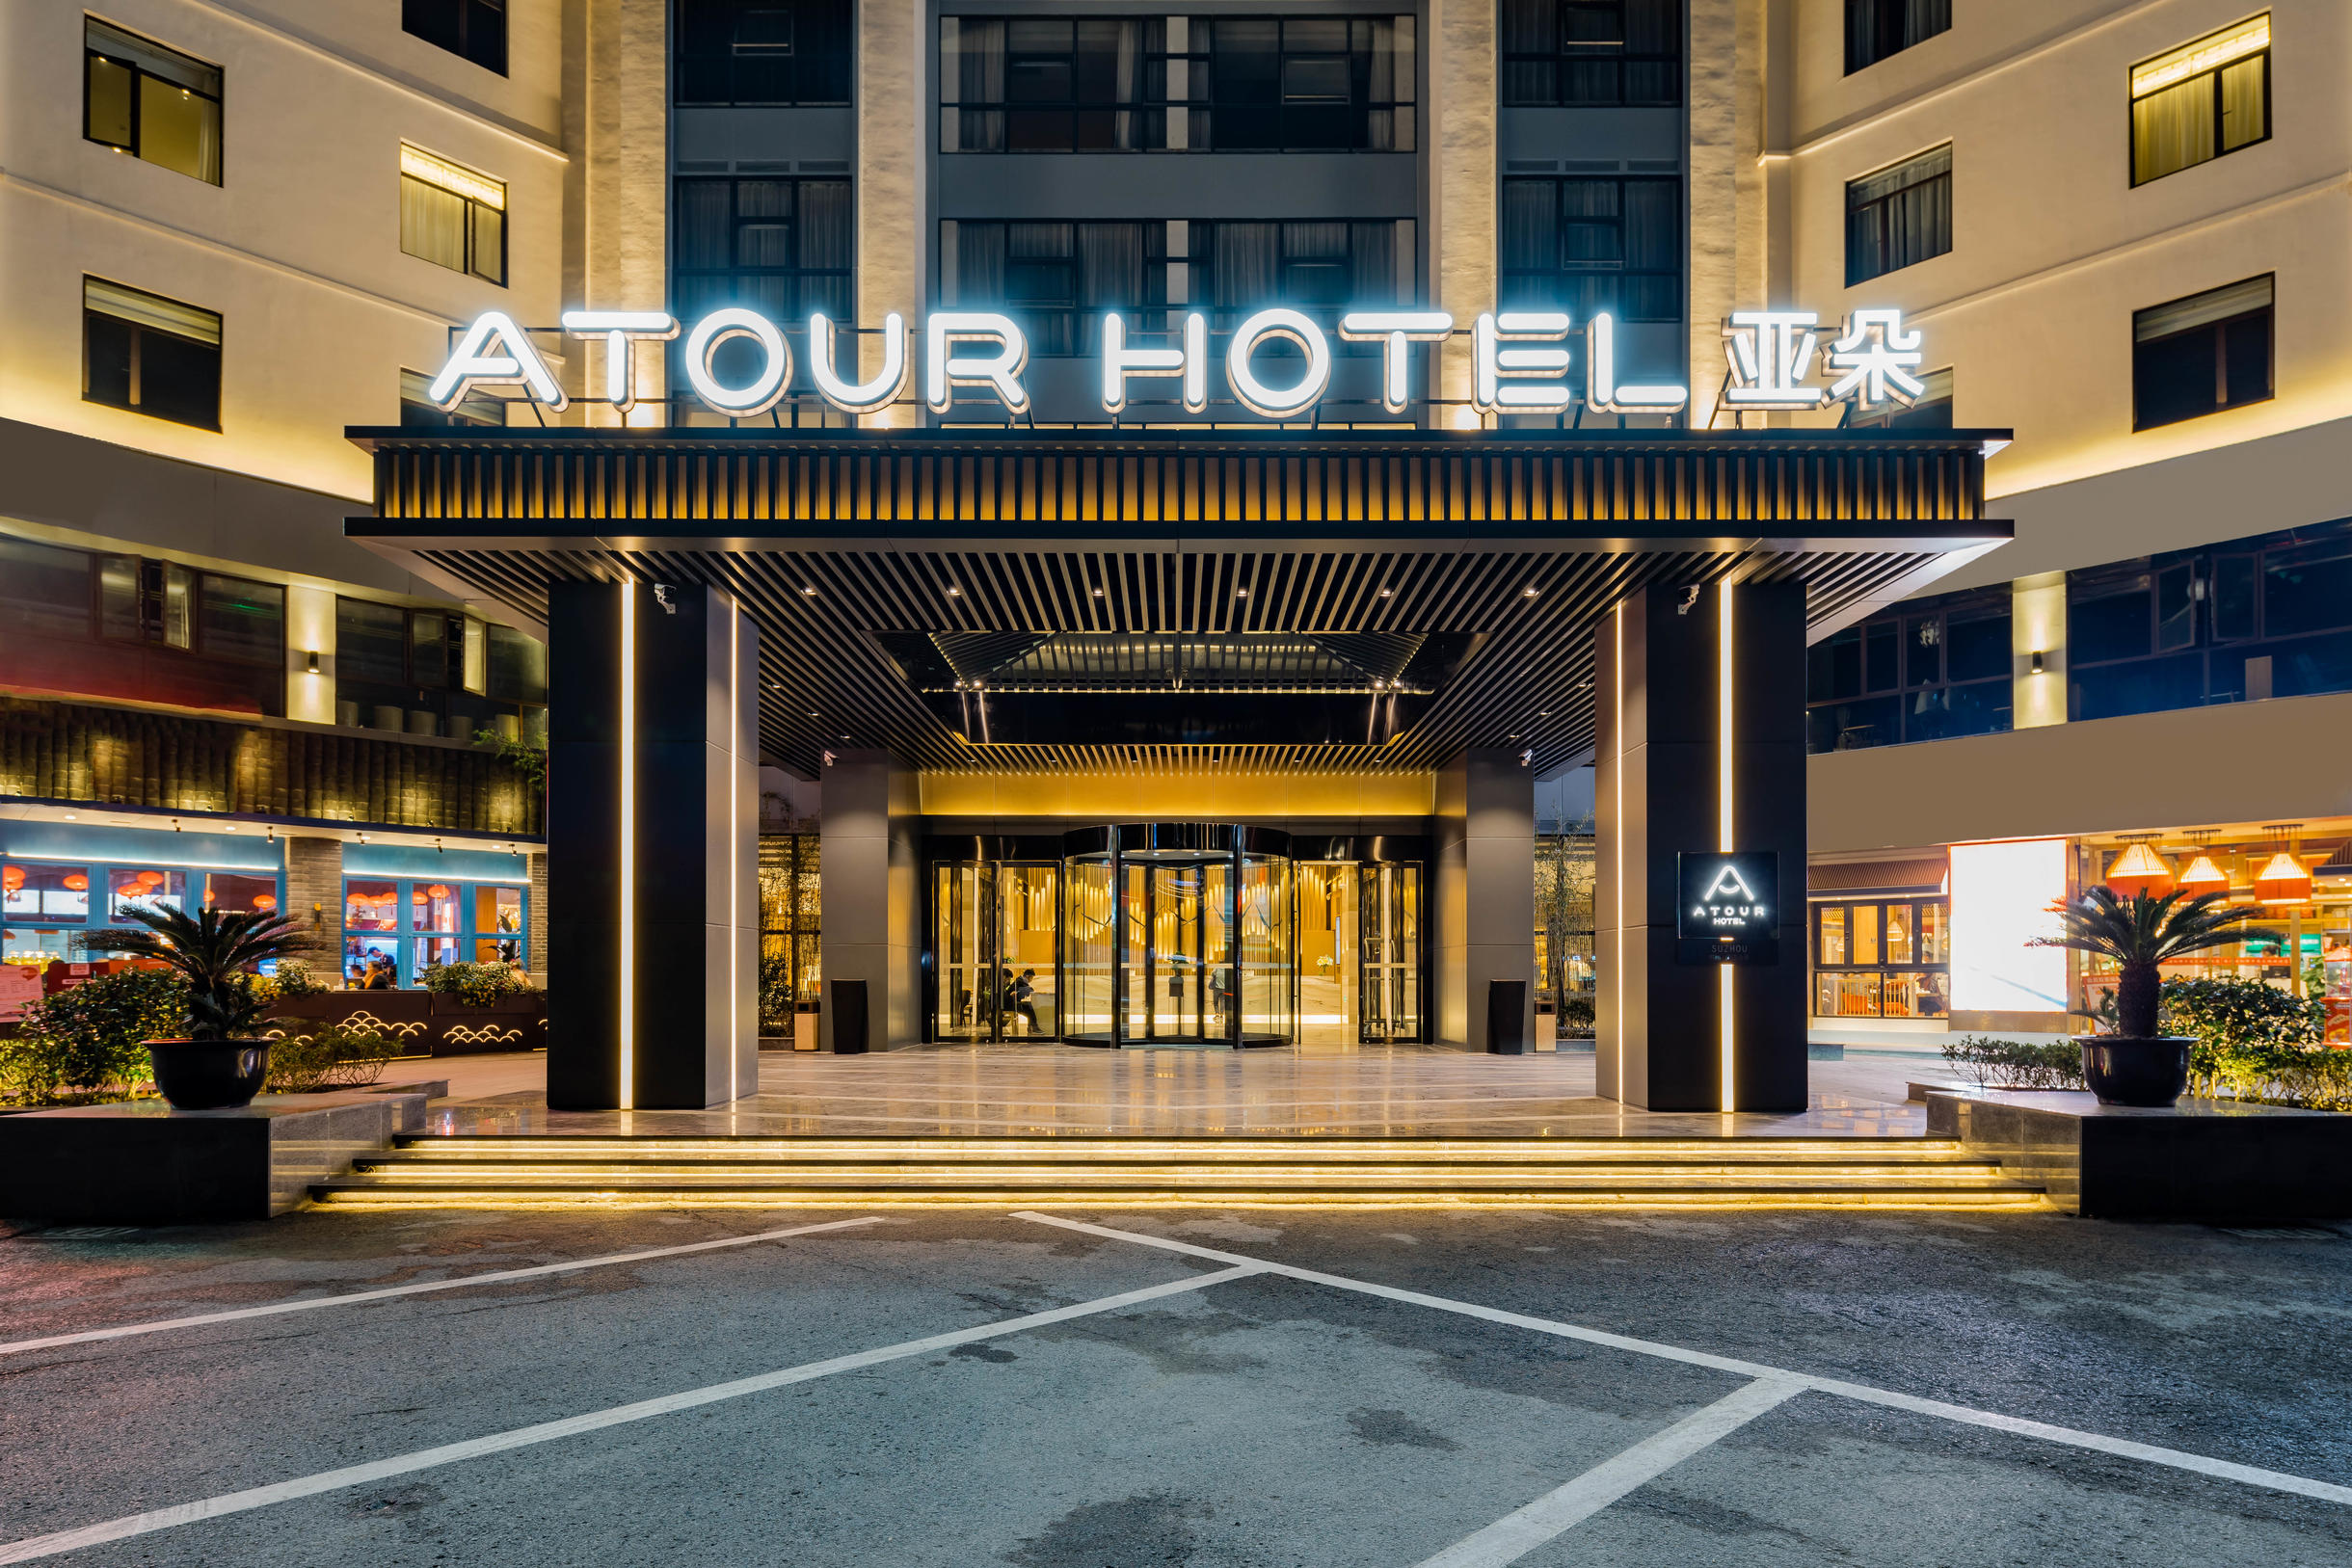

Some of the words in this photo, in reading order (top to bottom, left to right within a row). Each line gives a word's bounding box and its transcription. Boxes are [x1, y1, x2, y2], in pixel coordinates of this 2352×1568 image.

[429, 307, 1029, 412] ATOUR
[1104, 308, 1688, 412] HOTEL
[1724, 308, 1926, 406] 亚朵
[1693, 906, 1765, 917] ATOUR
[1711, 944, 1749, 953] SUZHOU
